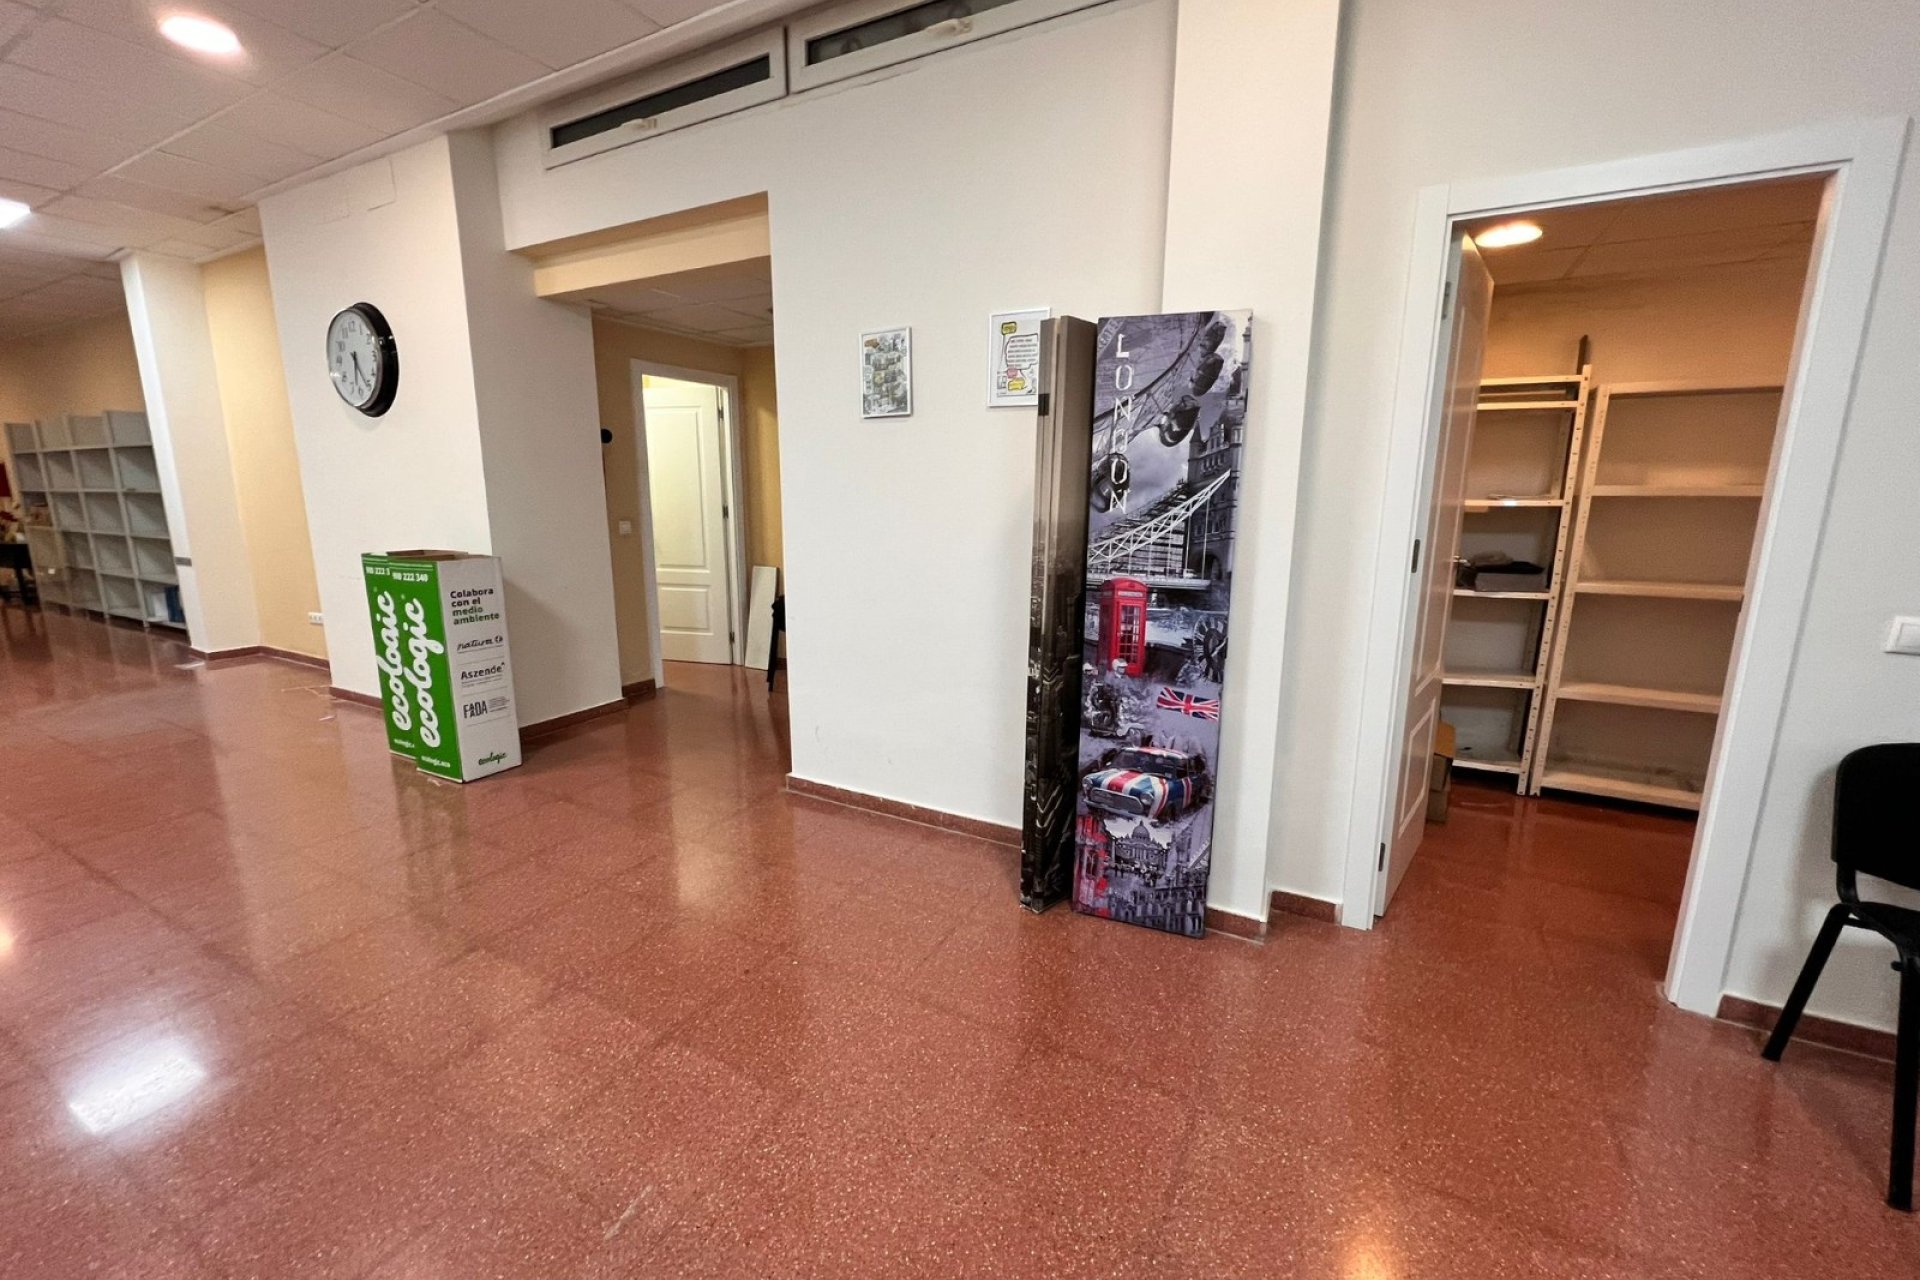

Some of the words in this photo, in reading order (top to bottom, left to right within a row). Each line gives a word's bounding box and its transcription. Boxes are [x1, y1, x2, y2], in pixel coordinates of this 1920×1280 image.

[1109, 333, 1134, 515] LONDON
[450, 589, 494, 598] Colabora
[451, 600, 470, 608] con
[472, 597, 481, 605] el
[452, 606, 483, 617] medio
[453, 613, 500, 625] ambiente
[403, 598, 444, 748] ecologic
